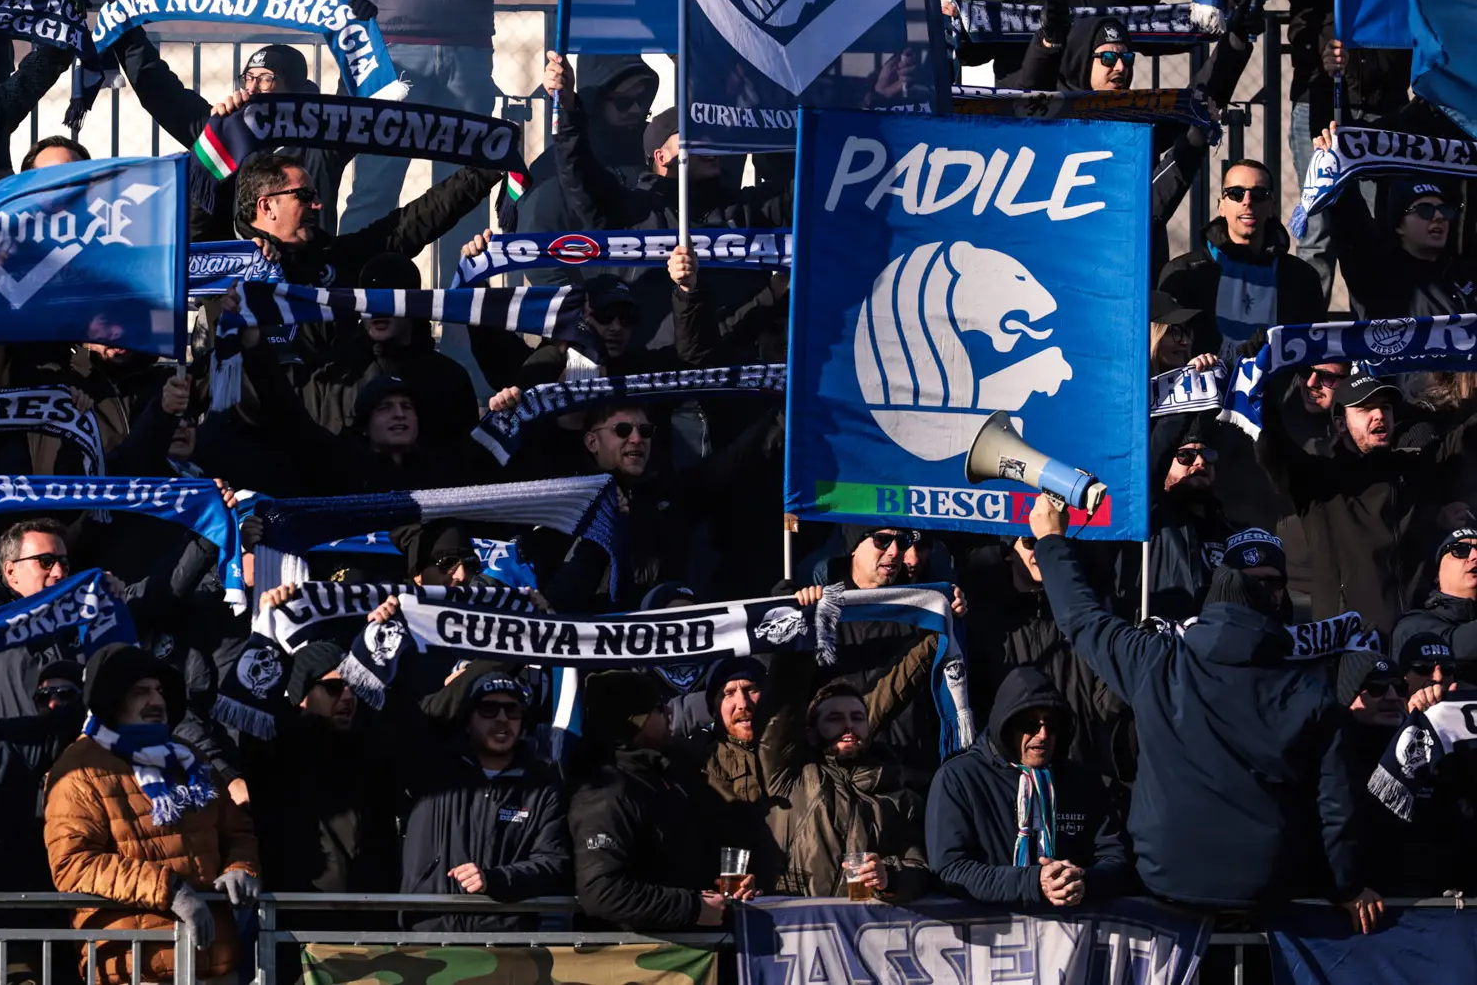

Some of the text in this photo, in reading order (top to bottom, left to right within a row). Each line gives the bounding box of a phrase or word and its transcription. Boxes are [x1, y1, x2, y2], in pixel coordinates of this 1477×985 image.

[243, 99, 514, 162] CASTEGNATO
[689, 101, 760, 129] CURVA
[825, 135, 1113, 221] PADILE
[435, 609, 716, 657] CURVA NORD
[1420, 643, 1450, 656] CNB
